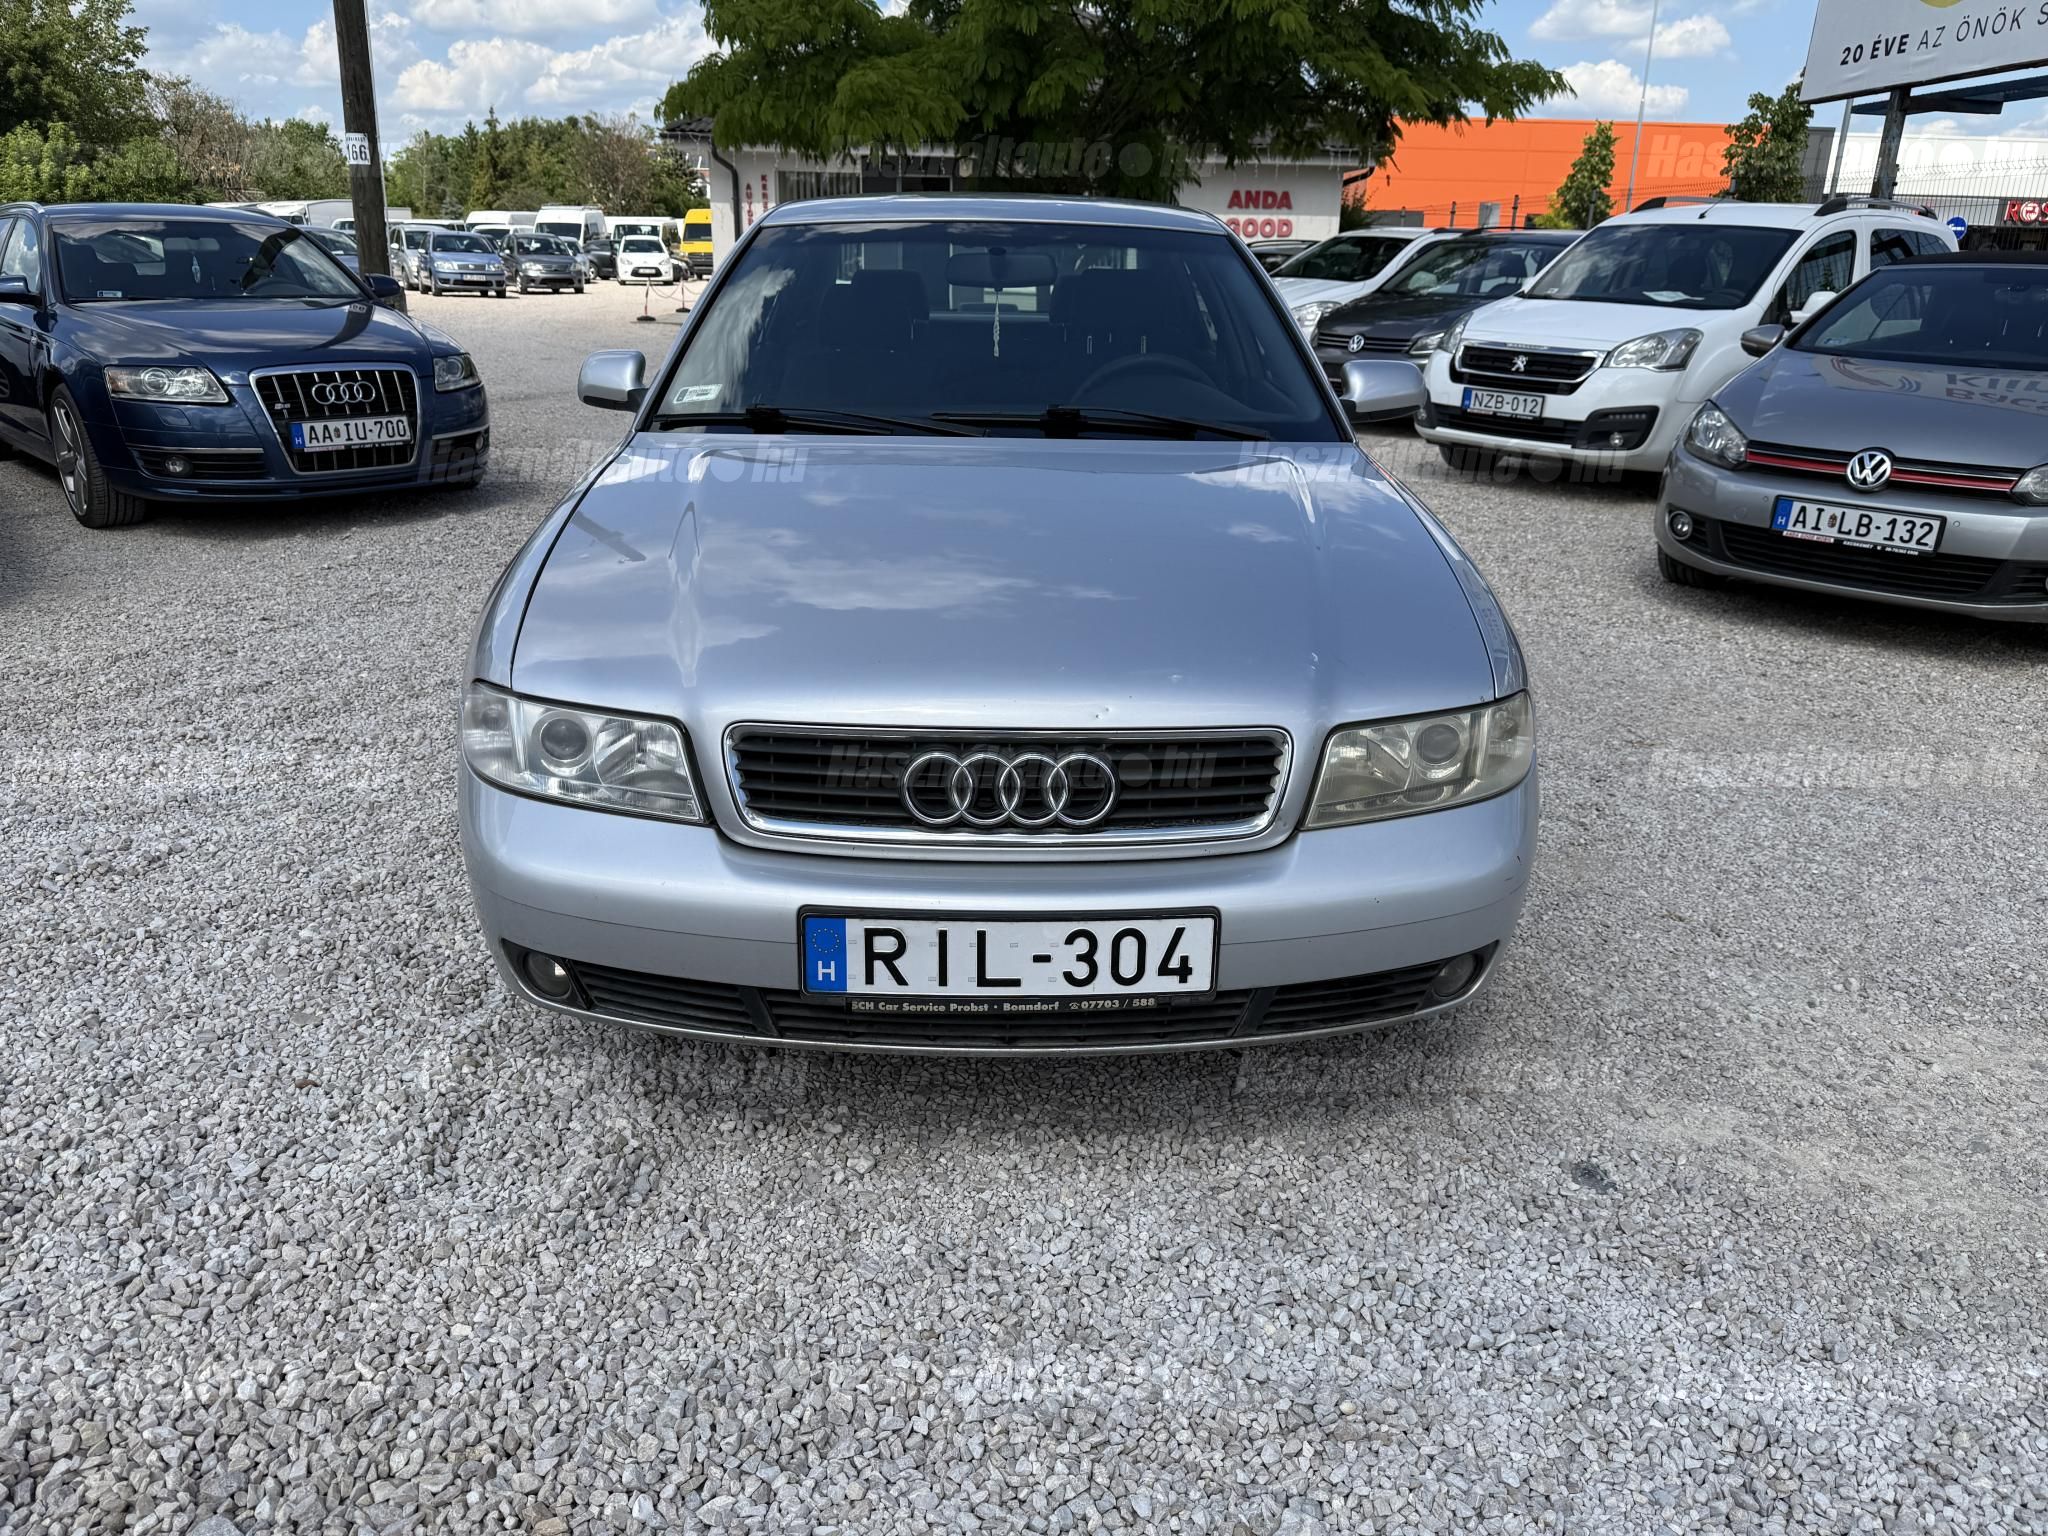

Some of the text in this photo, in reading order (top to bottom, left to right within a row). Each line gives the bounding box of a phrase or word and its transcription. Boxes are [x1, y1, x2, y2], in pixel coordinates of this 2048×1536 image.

[1840, 44, 1864, 66] 20
[1870, 33, 1909, 60] ÉVE
[1916, 25, 1946, 51] AZ
[1956, 7, 2026, 42] ÖNÖK
[1227, 189, 1293, 210] ANDA
[1226, 218, 1293, 238] GOOD
[1473, 391, 1538, 414] NZB-012
[308, 418, 407, 444] AA IU-700
[1792, 506, 1933, 546] AI LB-132
[864, 926, 1194, 988] RIL-304
[817, 960, 835, 982] H
[878, 1002, 899, 1011] Car
[902, 1002, 946, 1012] Service
[949, 1003, 989, 1012] Probst
[1003, 1001, 1060, 1011] Bonndorf
[1081, 1000, 1120, 1009] 07703
